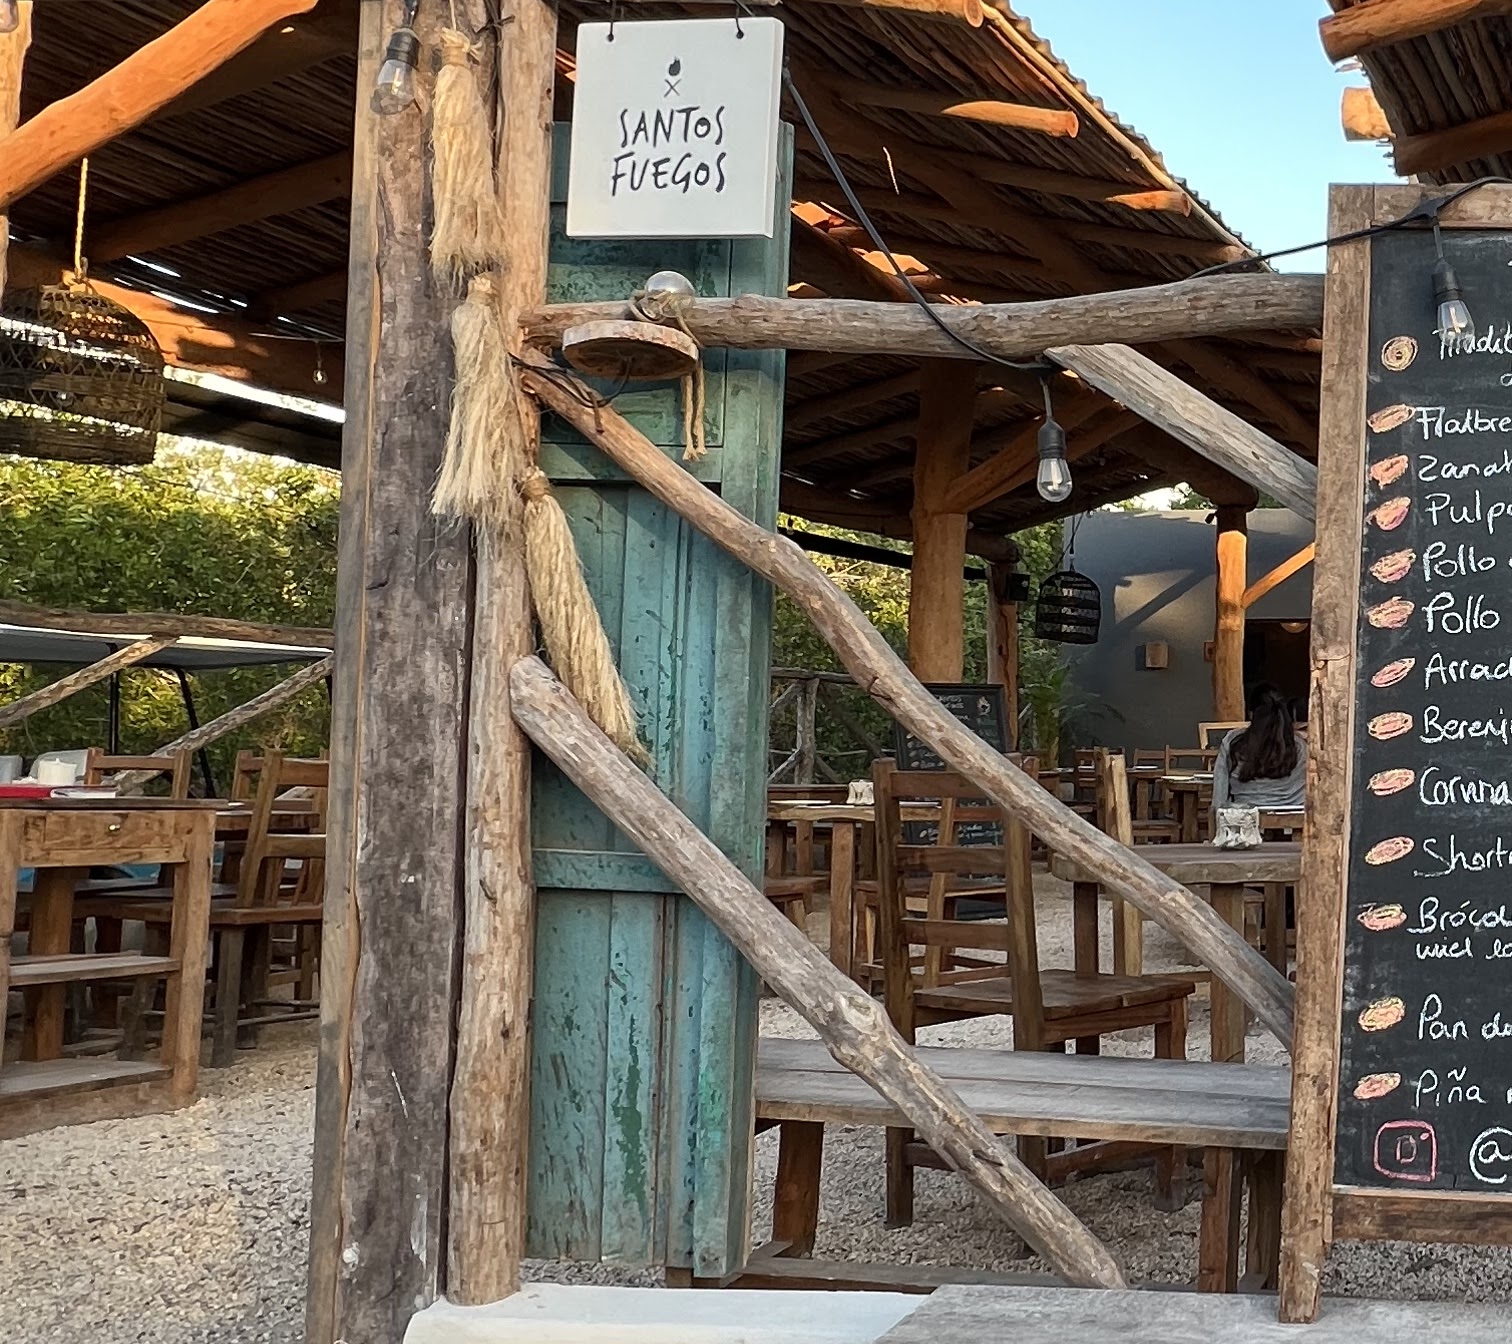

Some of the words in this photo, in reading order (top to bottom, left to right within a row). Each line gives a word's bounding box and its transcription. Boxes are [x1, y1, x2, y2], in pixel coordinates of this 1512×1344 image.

[620, 105, 725, 149] SANTOS
[612, 151, 727, 197] FUEGOS
[1422, 540, 1497, 583] Pollo
[1421, 590, 1501, 635] Pollo
[1415, 936, 1474, 960] miel
[1417, 993, 1469, 1042] Pan
[1414, 1065, 1486, 1109] Piña
